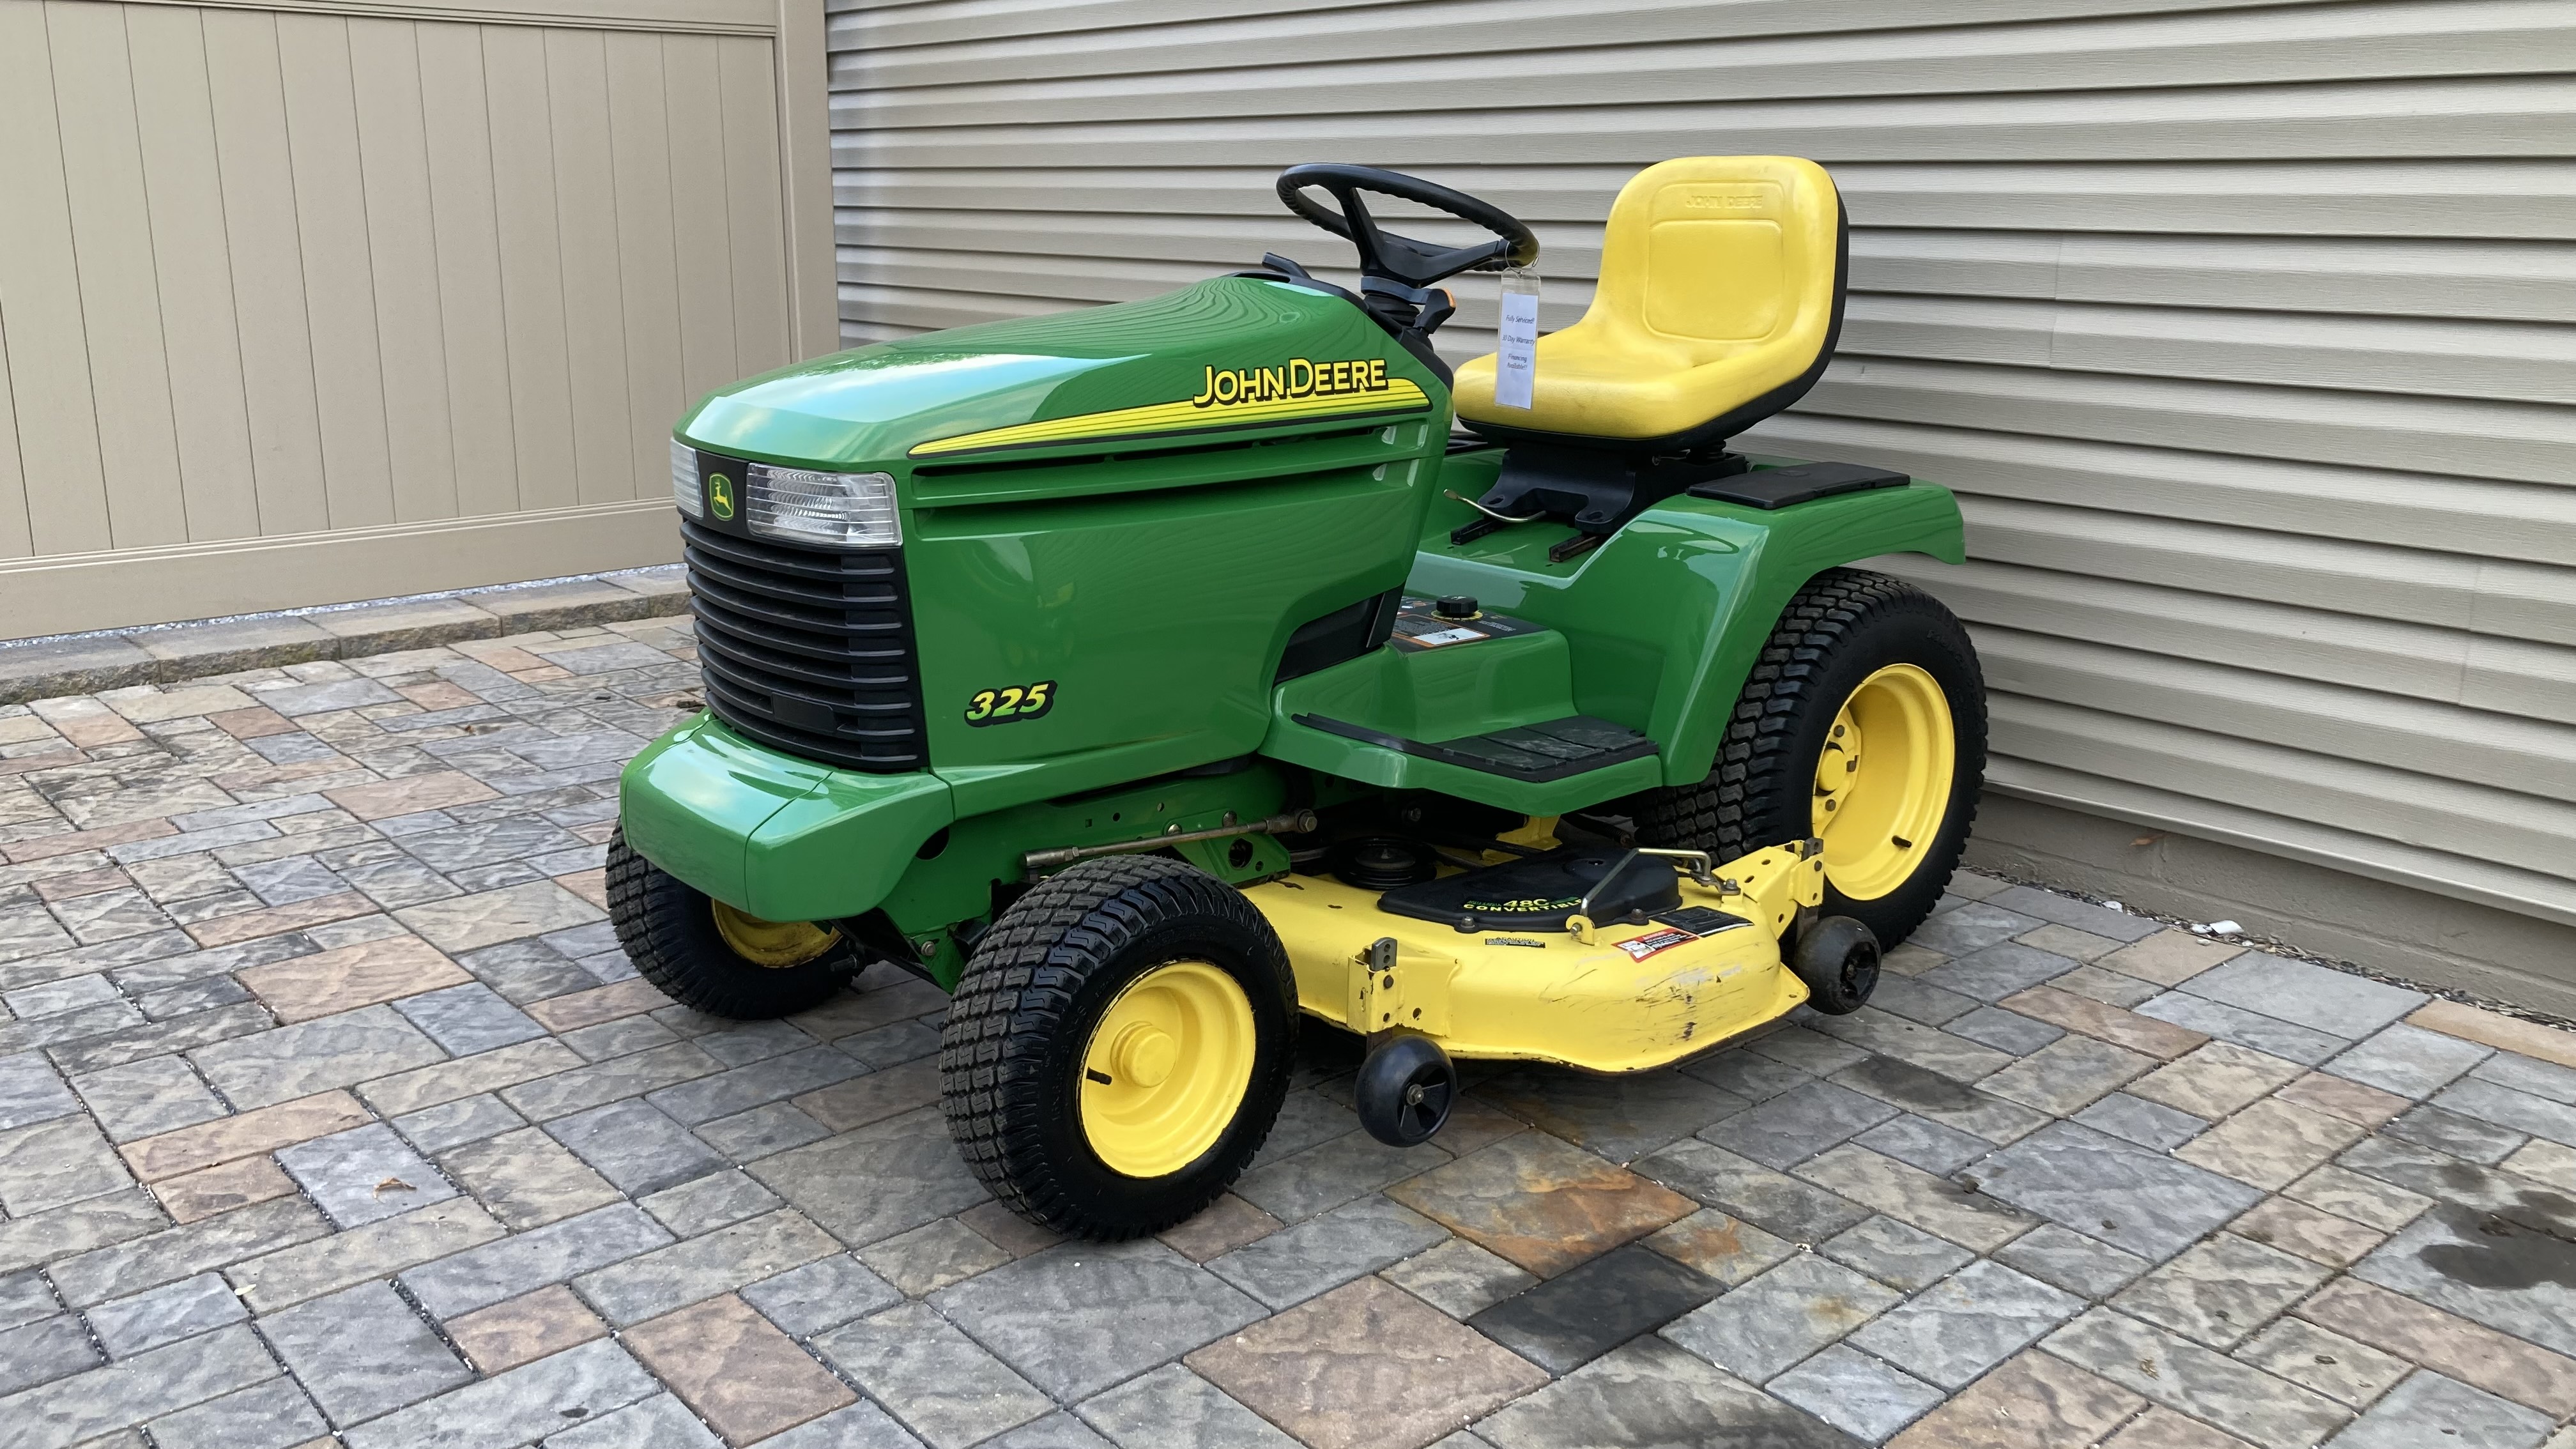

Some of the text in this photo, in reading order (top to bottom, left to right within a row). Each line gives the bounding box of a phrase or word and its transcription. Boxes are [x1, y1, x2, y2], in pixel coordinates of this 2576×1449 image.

[1686, 195, 1763, 209] JOHN DEERE
[1506, 315, 1515, 323] Fully
[1516, 336, 1535, 346] Warranty
[1508, 353, 1528, 363] Financing
[1193, 357, 1389, 408] JOHN DEERE
[965, 682, 1055, 726] 325
[1463, 898, 1583, 912] CONVERTIBLE
[1503, 898, 1549, 907] 48C
